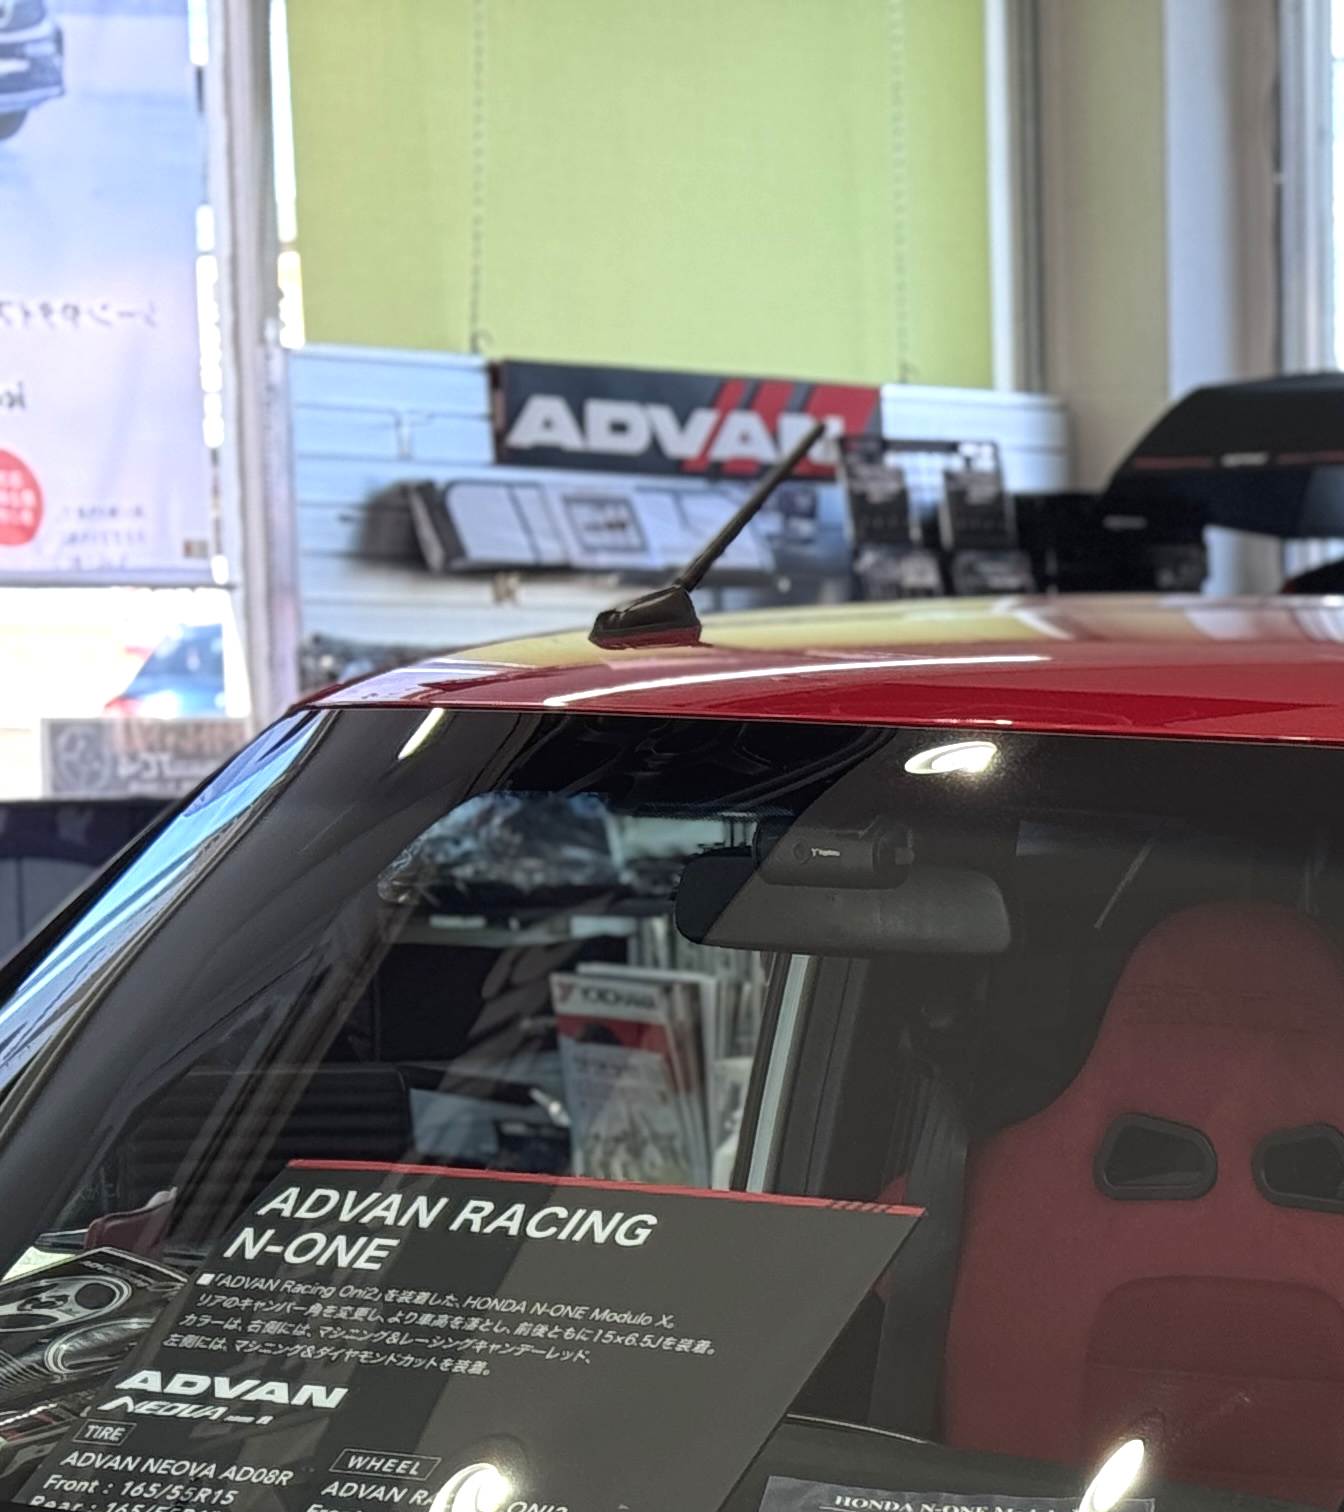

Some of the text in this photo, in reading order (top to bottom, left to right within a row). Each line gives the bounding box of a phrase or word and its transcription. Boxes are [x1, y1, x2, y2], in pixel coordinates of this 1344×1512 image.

[505, 391, 845, 464] ADVAN
[257, 1187, 658, 1247] ADVAN RACING
[223, 1227, 400, 1270] N-ONE
[282, 1279, 337, 1300] Racing
[529, 1302, 590, 1320] N-ONE
[589, 1307, 653, 1326] Modulo
[115, 1369, 349, 1409] ADVAN
[97, 1396, 229, 1421] NEOVA
[83, 1424, 127, 1442] TIRE
[60, 1451, 294, 1487] ADVAN NEOVA AD08R
[347, 1454, 422, 1476] WHEEL
[42, 1475, 102, 1494] Front
[119, 1481, 239, 1506] 165/55R15
[321, 1482, 409, 1503] ADVAN
